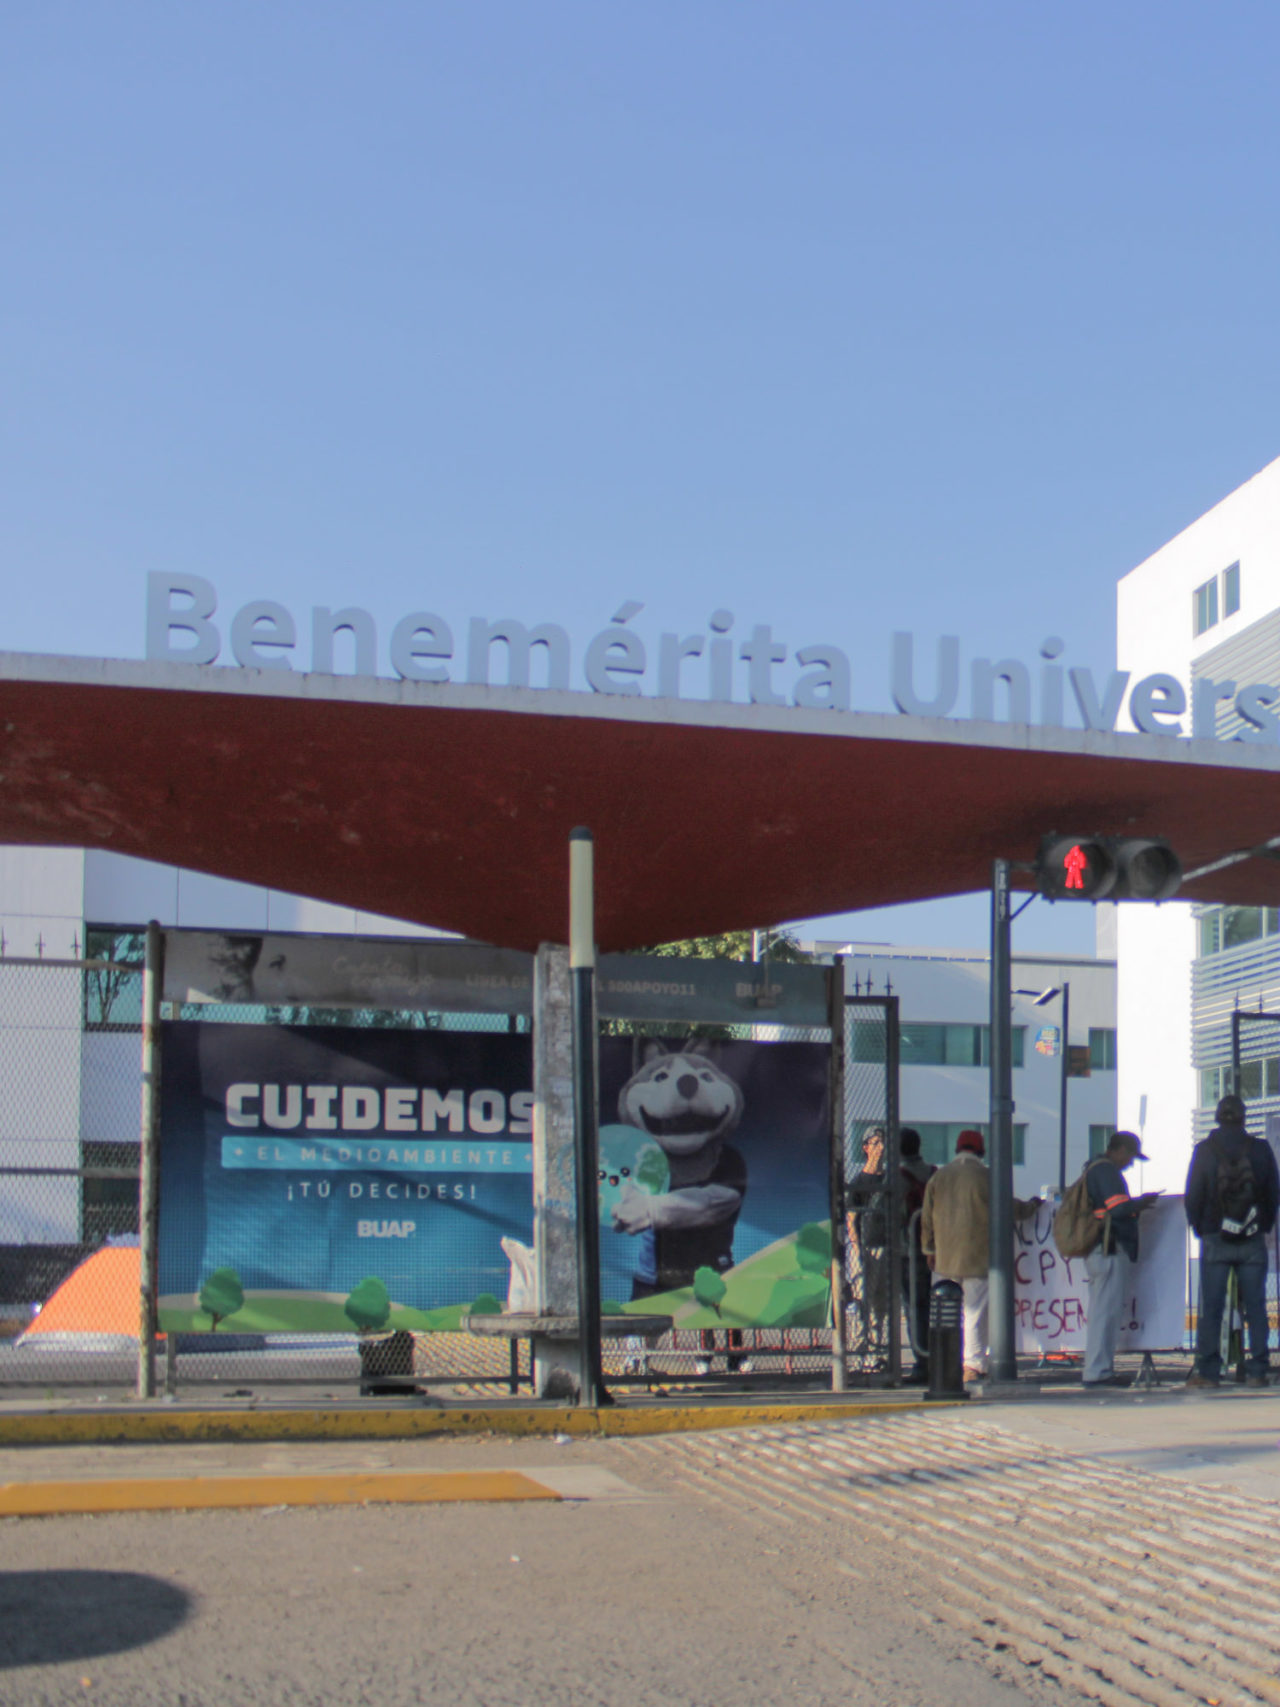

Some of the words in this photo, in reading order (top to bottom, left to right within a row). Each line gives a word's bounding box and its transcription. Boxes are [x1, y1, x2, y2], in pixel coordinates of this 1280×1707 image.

[145, 569, 850, 711] Benemérita
[226, 1083, 534, 1133] CUIDEMOS
[257, 1146, 285, 1161] EL
[301, 1147, 513, 1165] MEDIOAMBIENTE
[287, 1180, 331, 1200] ¡TÚ
[350, 1183, 477, 1200] DECIDES!
[357, 1220, 416, 1238] BUAP
